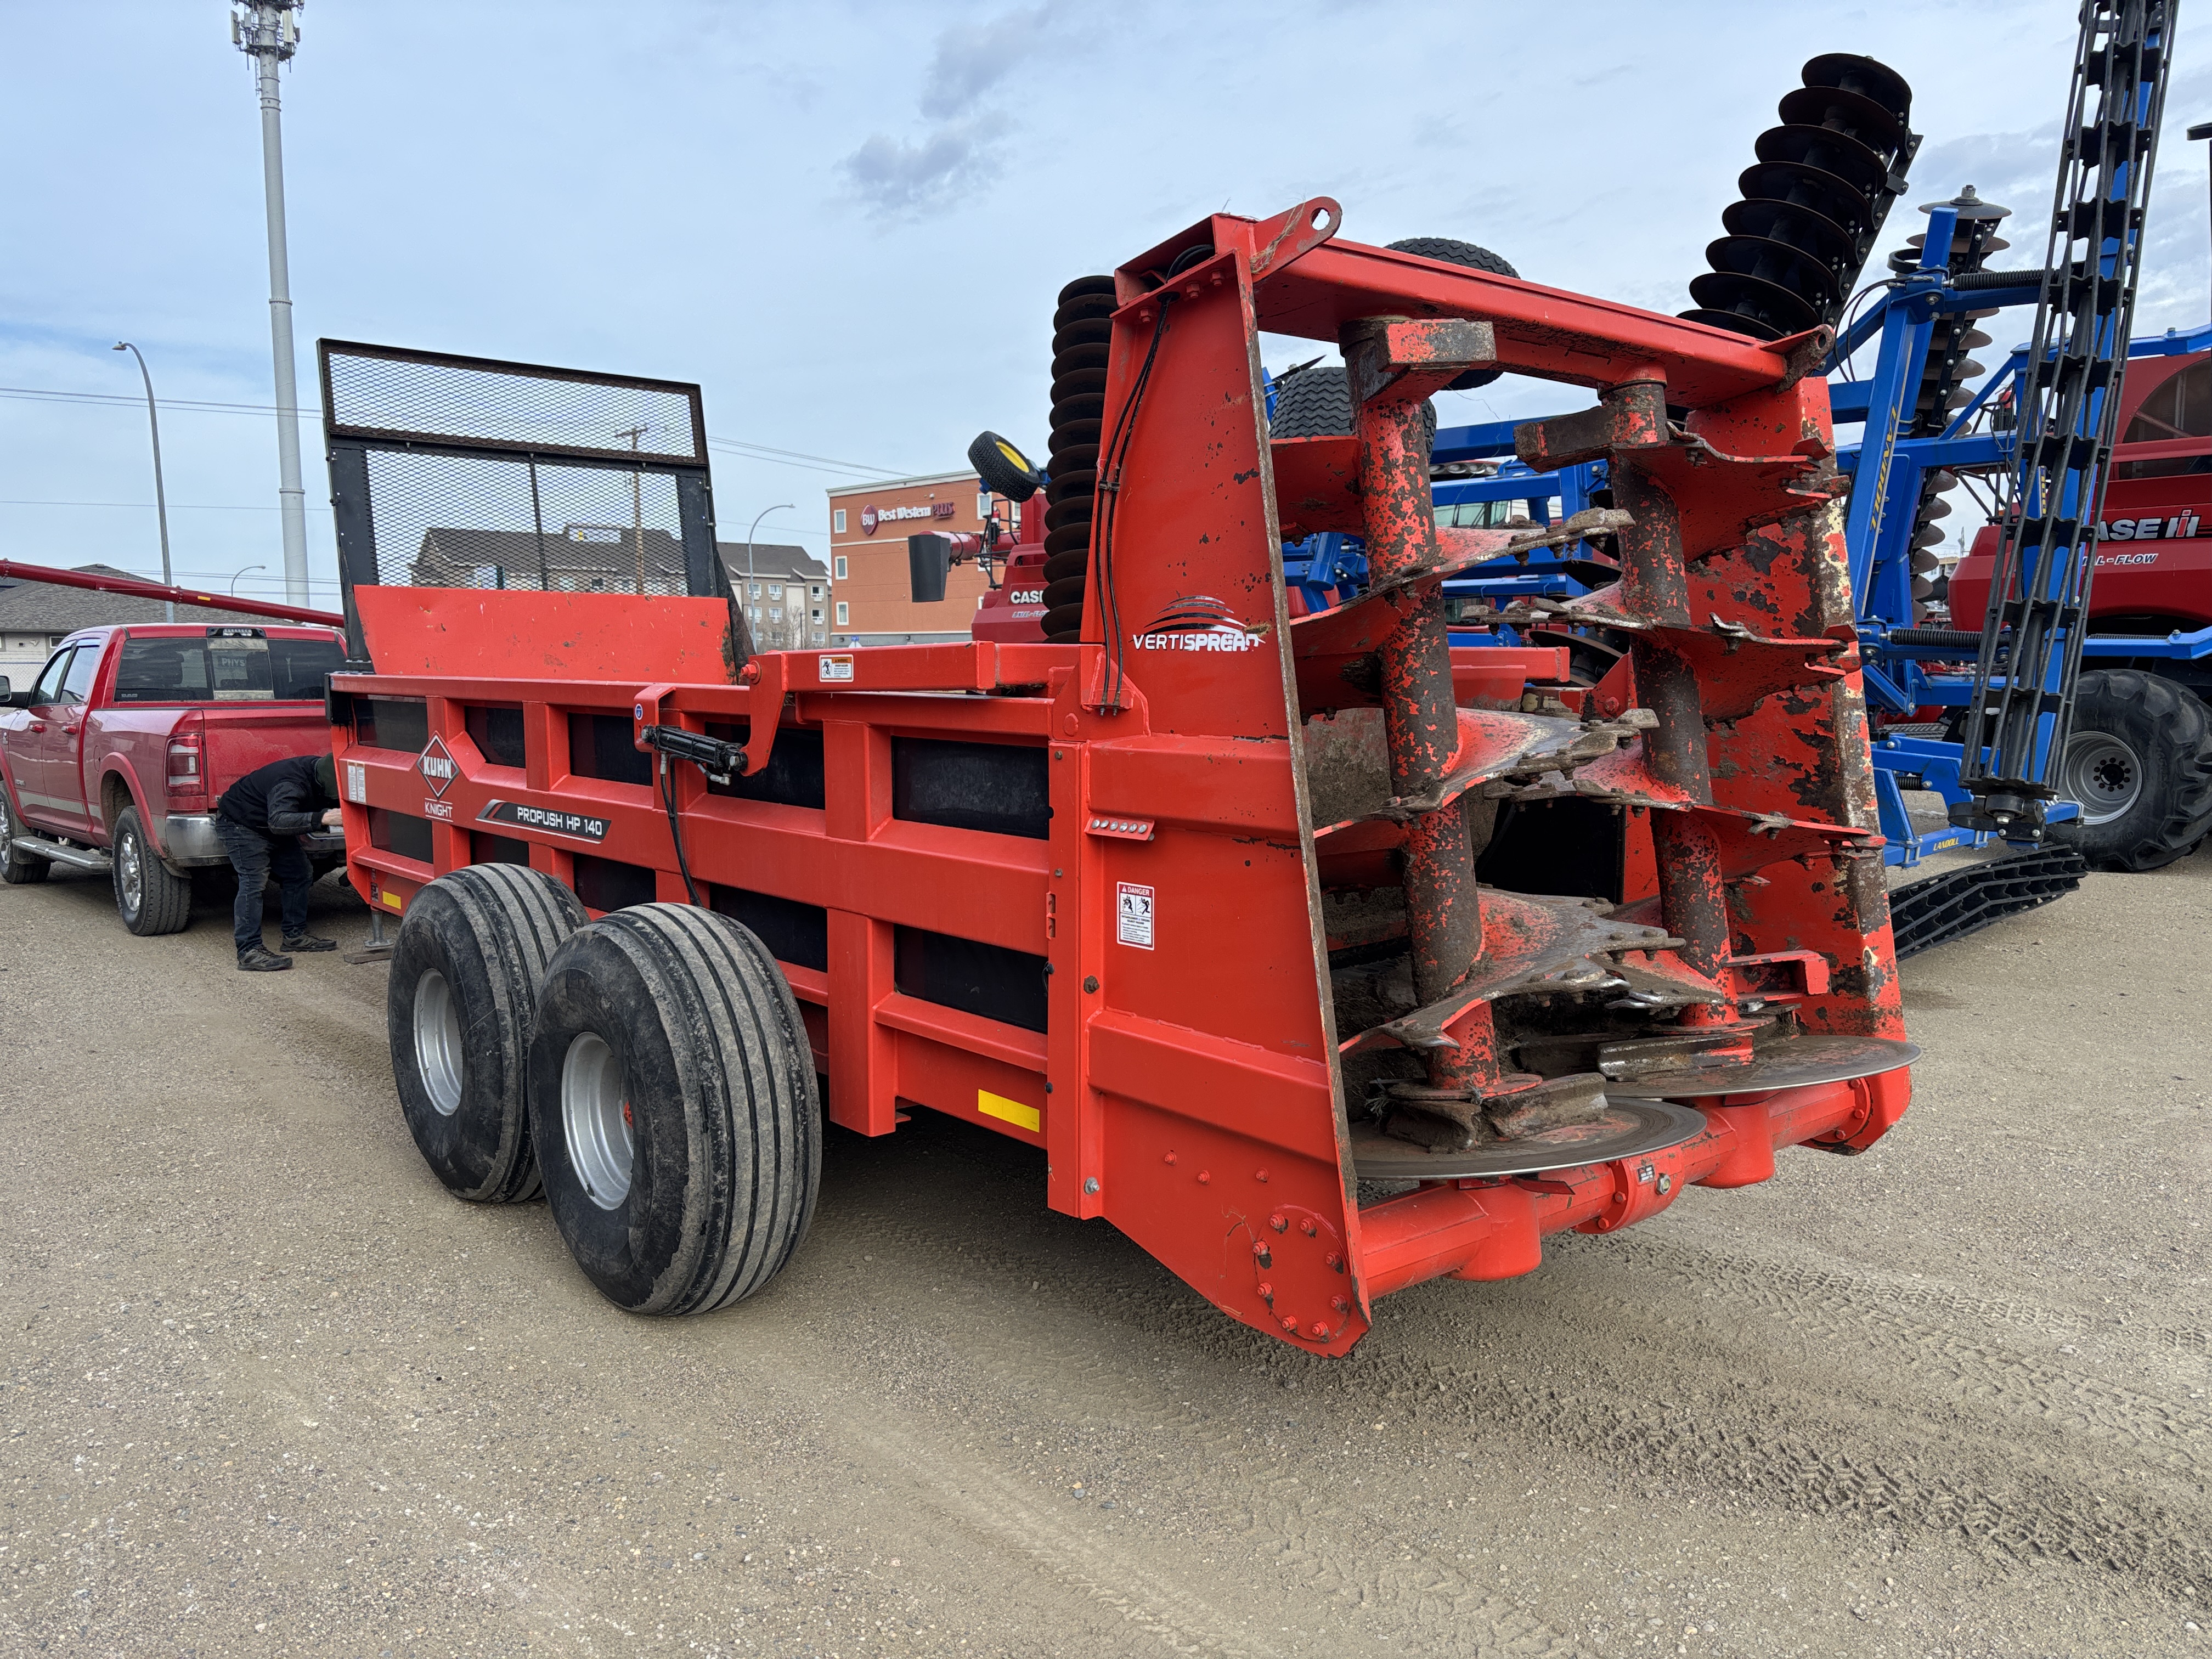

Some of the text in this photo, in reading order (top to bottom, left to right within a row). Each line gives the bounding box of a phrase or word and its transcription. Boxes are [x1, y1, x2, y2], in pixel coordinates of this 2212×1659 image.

[1870, 404, 1897, 531] LANDOLL
[862, 514, 875, 526] BW
[878, 509, 896, 521] Best
[897, 507, 931, 520] Western
[2097, 518, 2162, 540] ASE
[424, 755, 452, 778] KUHN
[425, 802, 453, 818] KNIGHT
[517, 806, 602, 836] PROPUSH HP 140
[1127, 886, 1150, 896] DANGER
